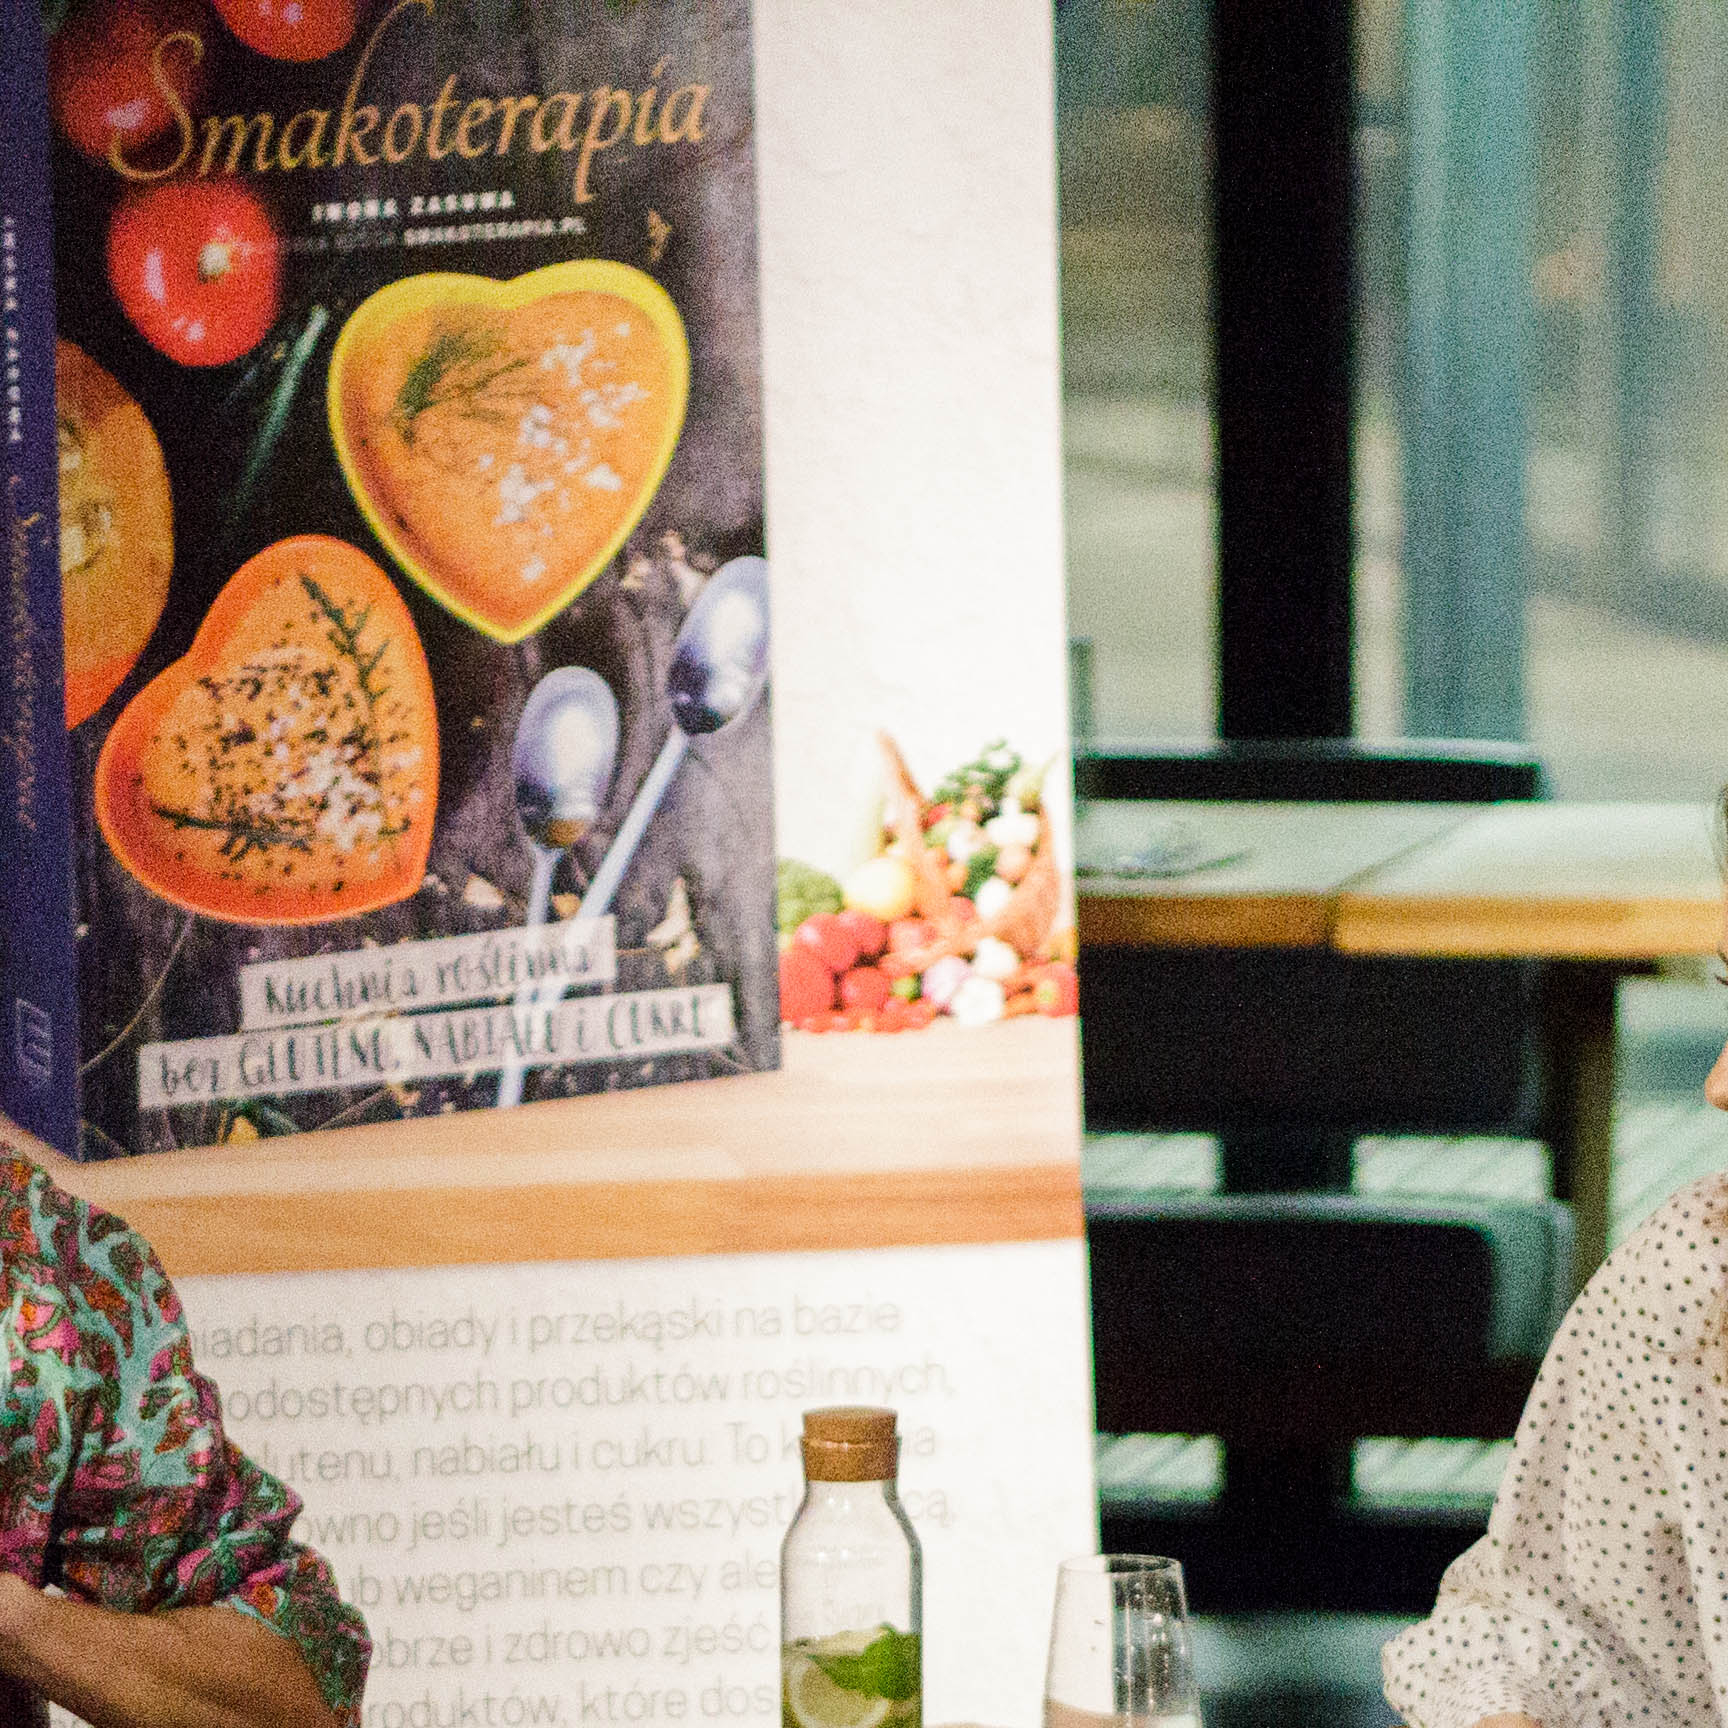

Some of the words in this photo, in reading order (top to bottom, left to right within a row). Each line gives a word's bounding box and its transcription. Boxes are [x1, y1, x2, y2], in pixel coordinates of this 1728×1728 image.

[106, 0, 709, 203] Smakoterapia
[160, 1061, 221, 1096] bez
[363, 1306, 499, 1359] obiady
[732, 1303, 783, 1337] na
[792, 1294, 903, 1336] bazie
[224, 1371, 499, 1428] odostępnych
[509, 1361, 732, 1418] produktów
[410, 1433, 561, 1480] nabiału
[725, 1420, 770, 1466] To
[407, 1503, 492, 1552] jeśli
[499, 1493, 633, 1550] jesteś
[392, 1562, 629, 1613] weganinem
[637, 1562, 709, 1600] czy
[371, 1623, 474, 1670] obrze
[503, 1617, 653, 1664] zdrowo
[578, 1681, 690, 1724] które
